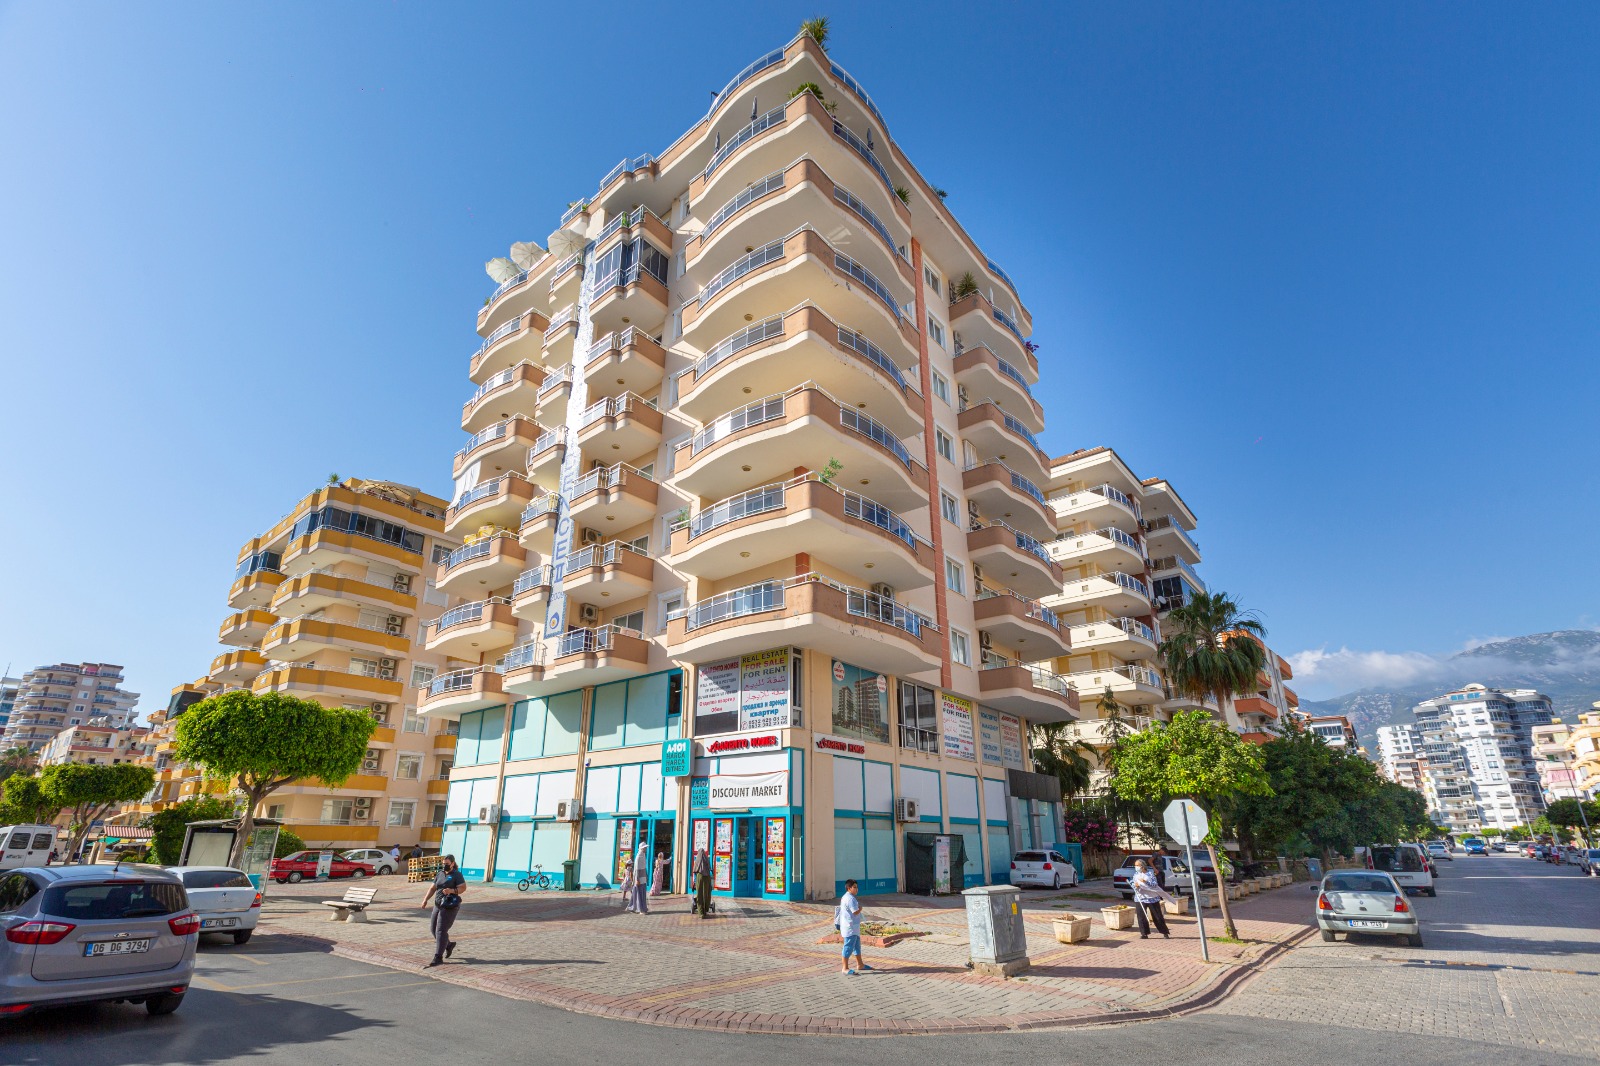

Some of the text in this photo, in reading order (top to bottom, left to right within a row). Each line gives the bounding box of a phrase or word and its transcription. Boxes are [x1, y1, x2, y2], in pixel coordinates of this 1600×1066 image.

[742, 648, 788, 663] REAL ESTATE
[745, 657, 785, 671] FOR SALE
[743, 670, 760, 679] FOR
[763, 665, 786, 675] RENT
[942, 707, 954, 715] FOR
[955, 710, 970, 720] RENT
[943, 701, 969, 714] FOR SALE
[665, 759, 685, 767] HARCA
[666, 752, 686, 760] HARCA
[712, 784, 783, 798] DISCOUNT MARKET
[93, 939, 147, 953] 06 DG 3794
